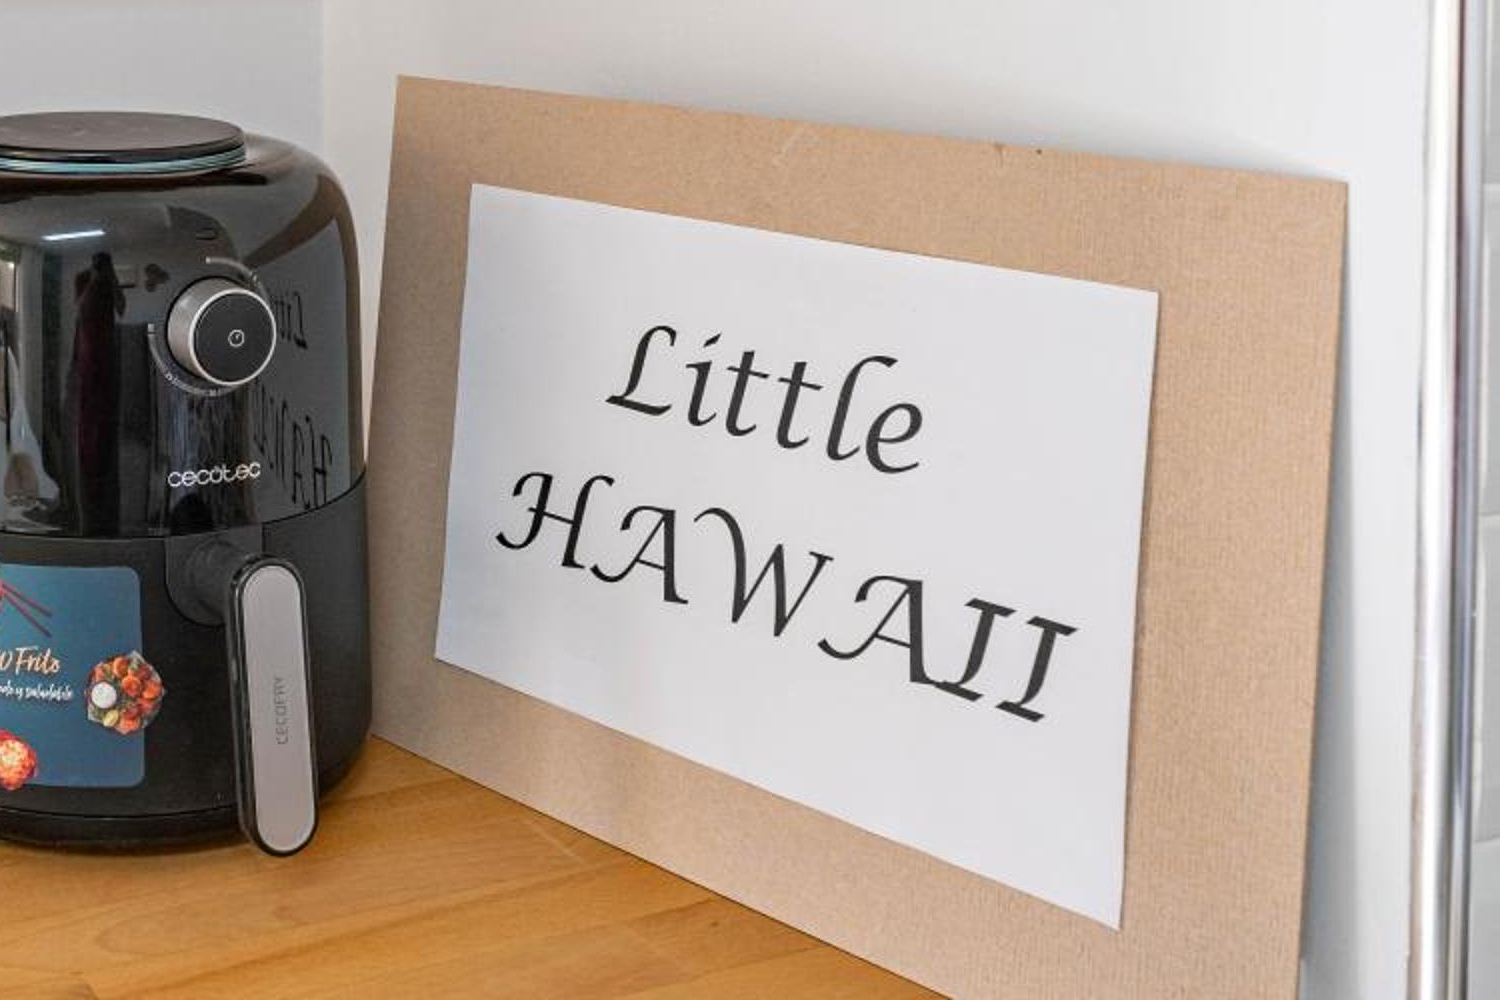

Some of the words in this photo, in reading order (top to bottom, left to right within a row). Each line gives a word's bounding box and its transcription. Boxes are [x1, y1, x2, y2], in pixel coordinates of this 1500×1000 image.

[167, 461, 261, 487] cecotec
[605, 325, 924, 475] Little
[494, 471, 1079, 724] HAWAII
